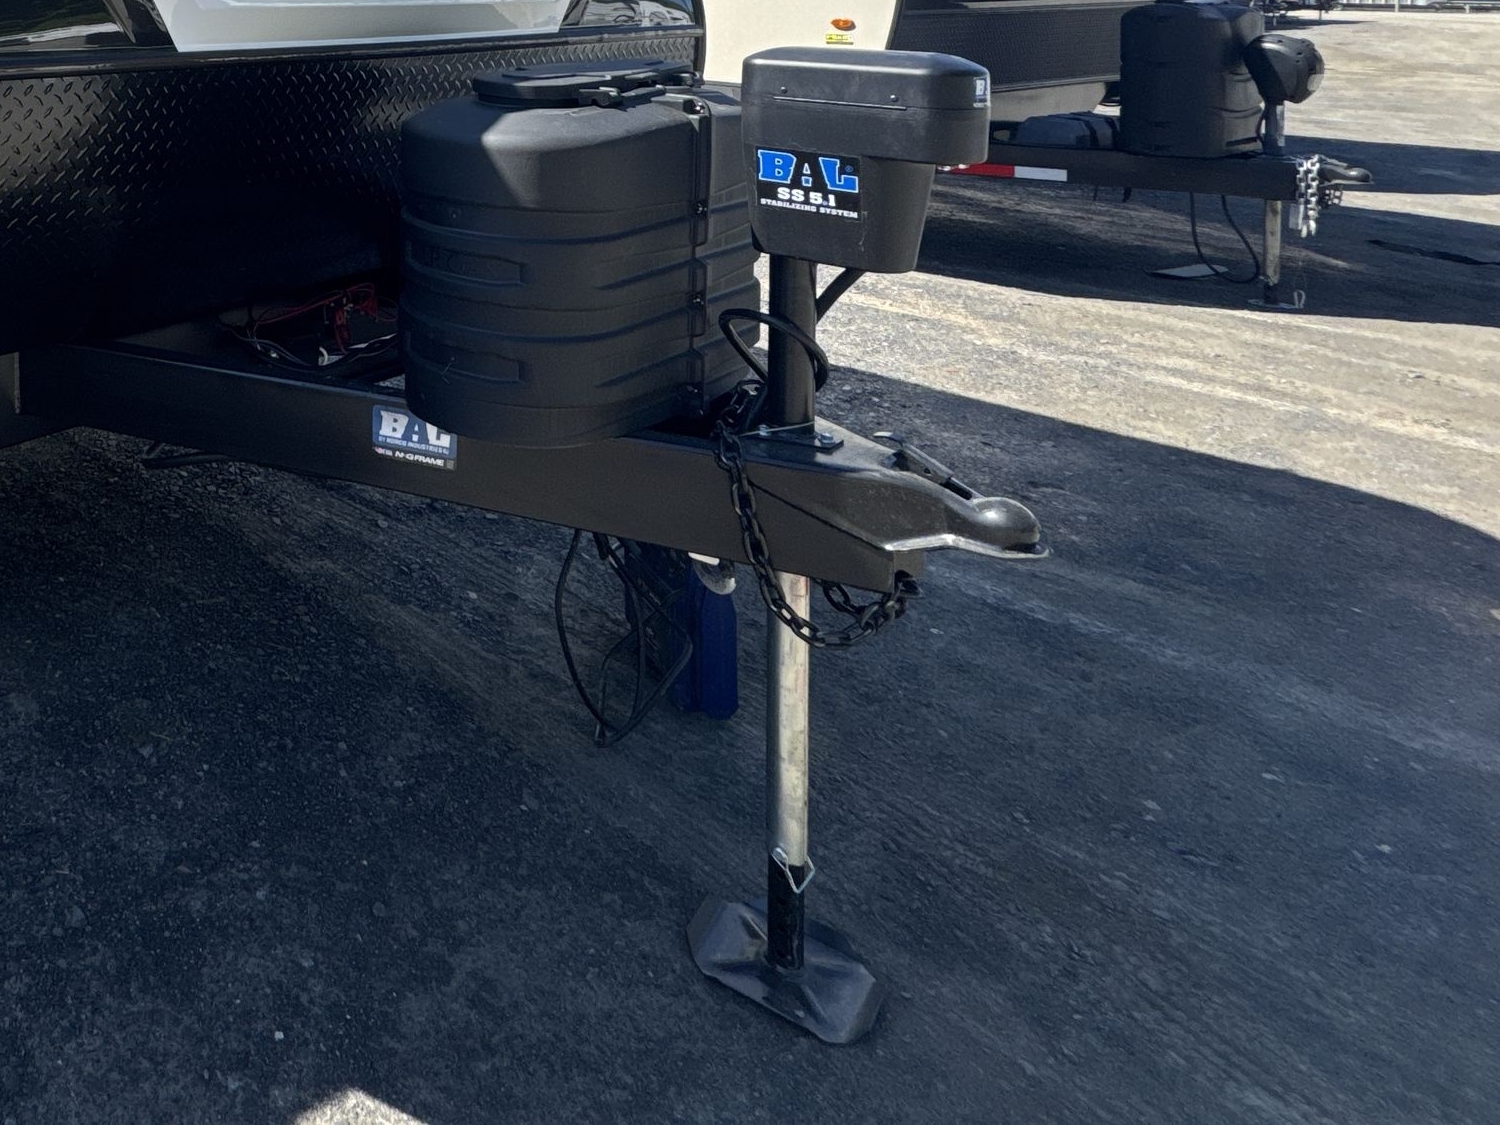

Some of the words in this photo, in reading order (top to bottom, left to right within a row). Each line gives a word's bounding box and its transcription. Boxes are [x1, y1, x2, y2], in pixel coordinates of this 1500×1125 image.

[758, 149, 859, 193] BAL
[760, 198, 817, 212] STABILIZING
[819, 206, 858, 219] SYSTEM
[777, 187, 805, 202] SS
[809, 191, 836, 207] 5.1
[379, 410, 450, 448] BAL
